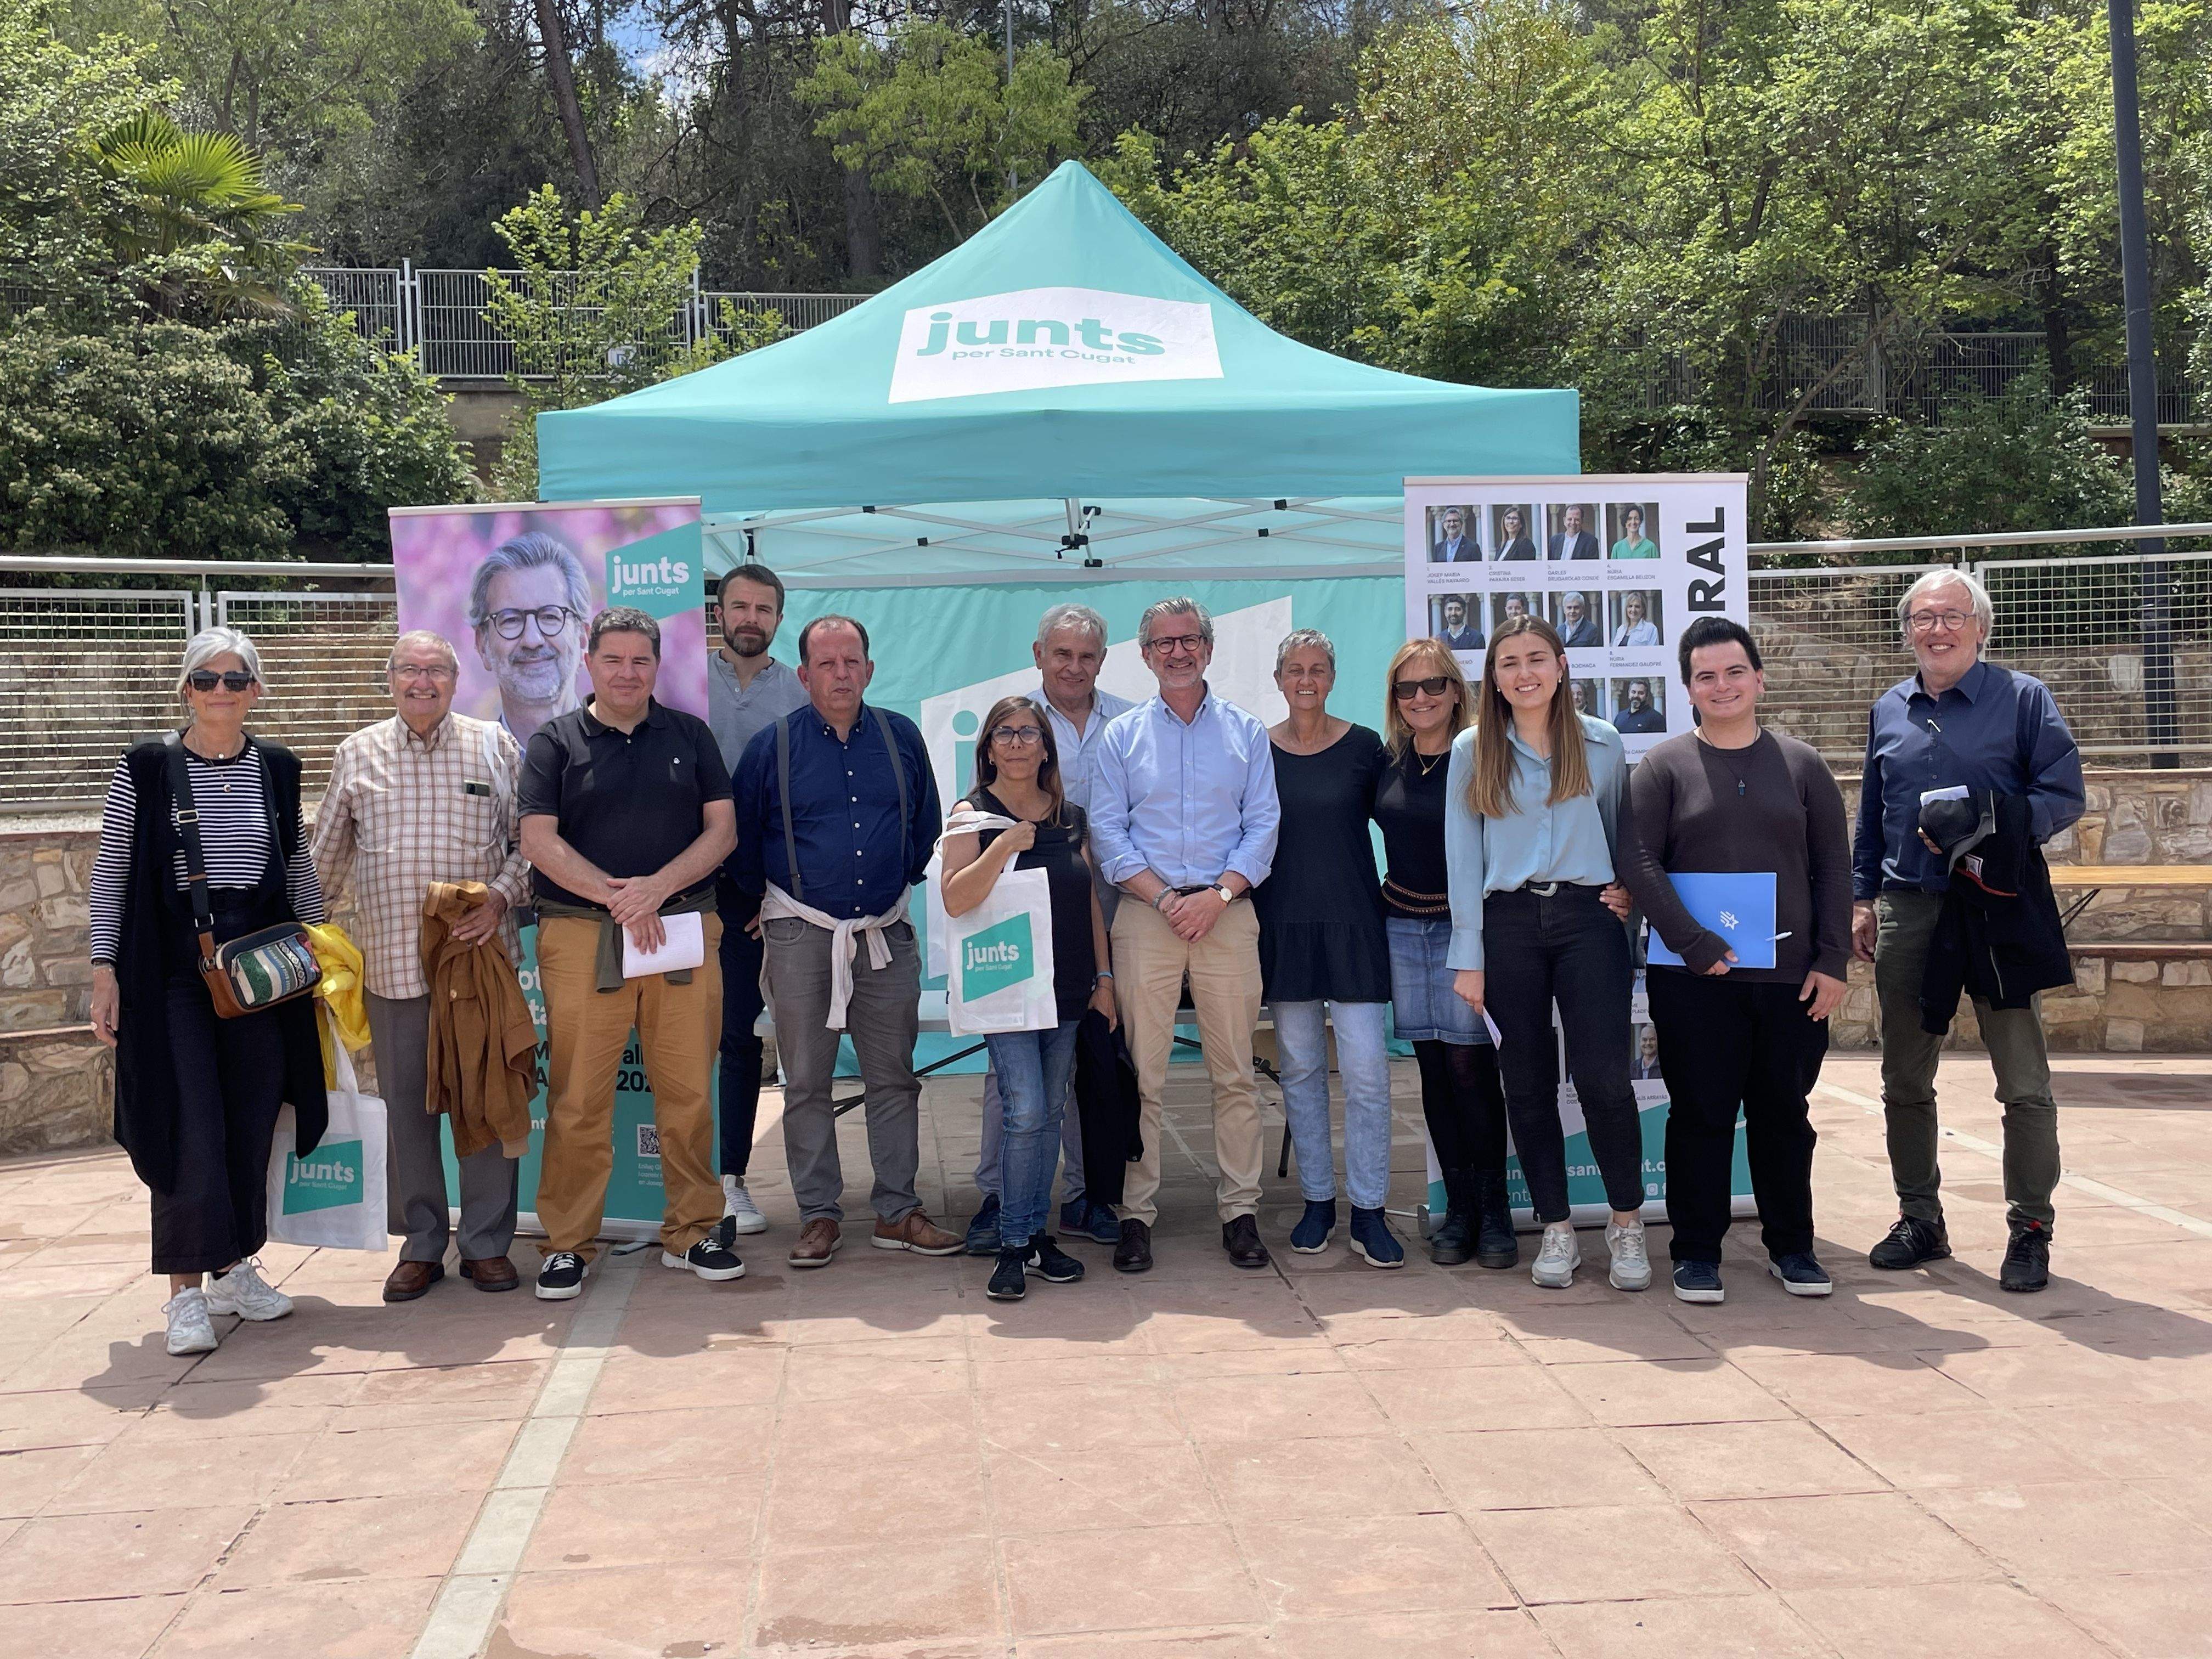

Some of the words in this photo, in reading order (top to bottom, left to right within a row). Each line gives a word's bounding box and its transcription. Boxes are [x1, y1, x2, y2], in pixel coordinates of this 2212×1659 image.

[917, 312, 1165, 356] junts
[952, 350, 994, 360] per
[1000, 348, 1054, 358] Sant
[1060, 350, 1136, 364] Cugat
[1686, 506, 1726, 612] RAL
[612, 555, 690, 594] junts
[623, 589, 636, 597] per
[637, 587, 653, 595] Sant
[655, 586, 679, 596] Cugat
[967, 940, 1019, 970] junts
[290, 1156, 354, 1184] junts
